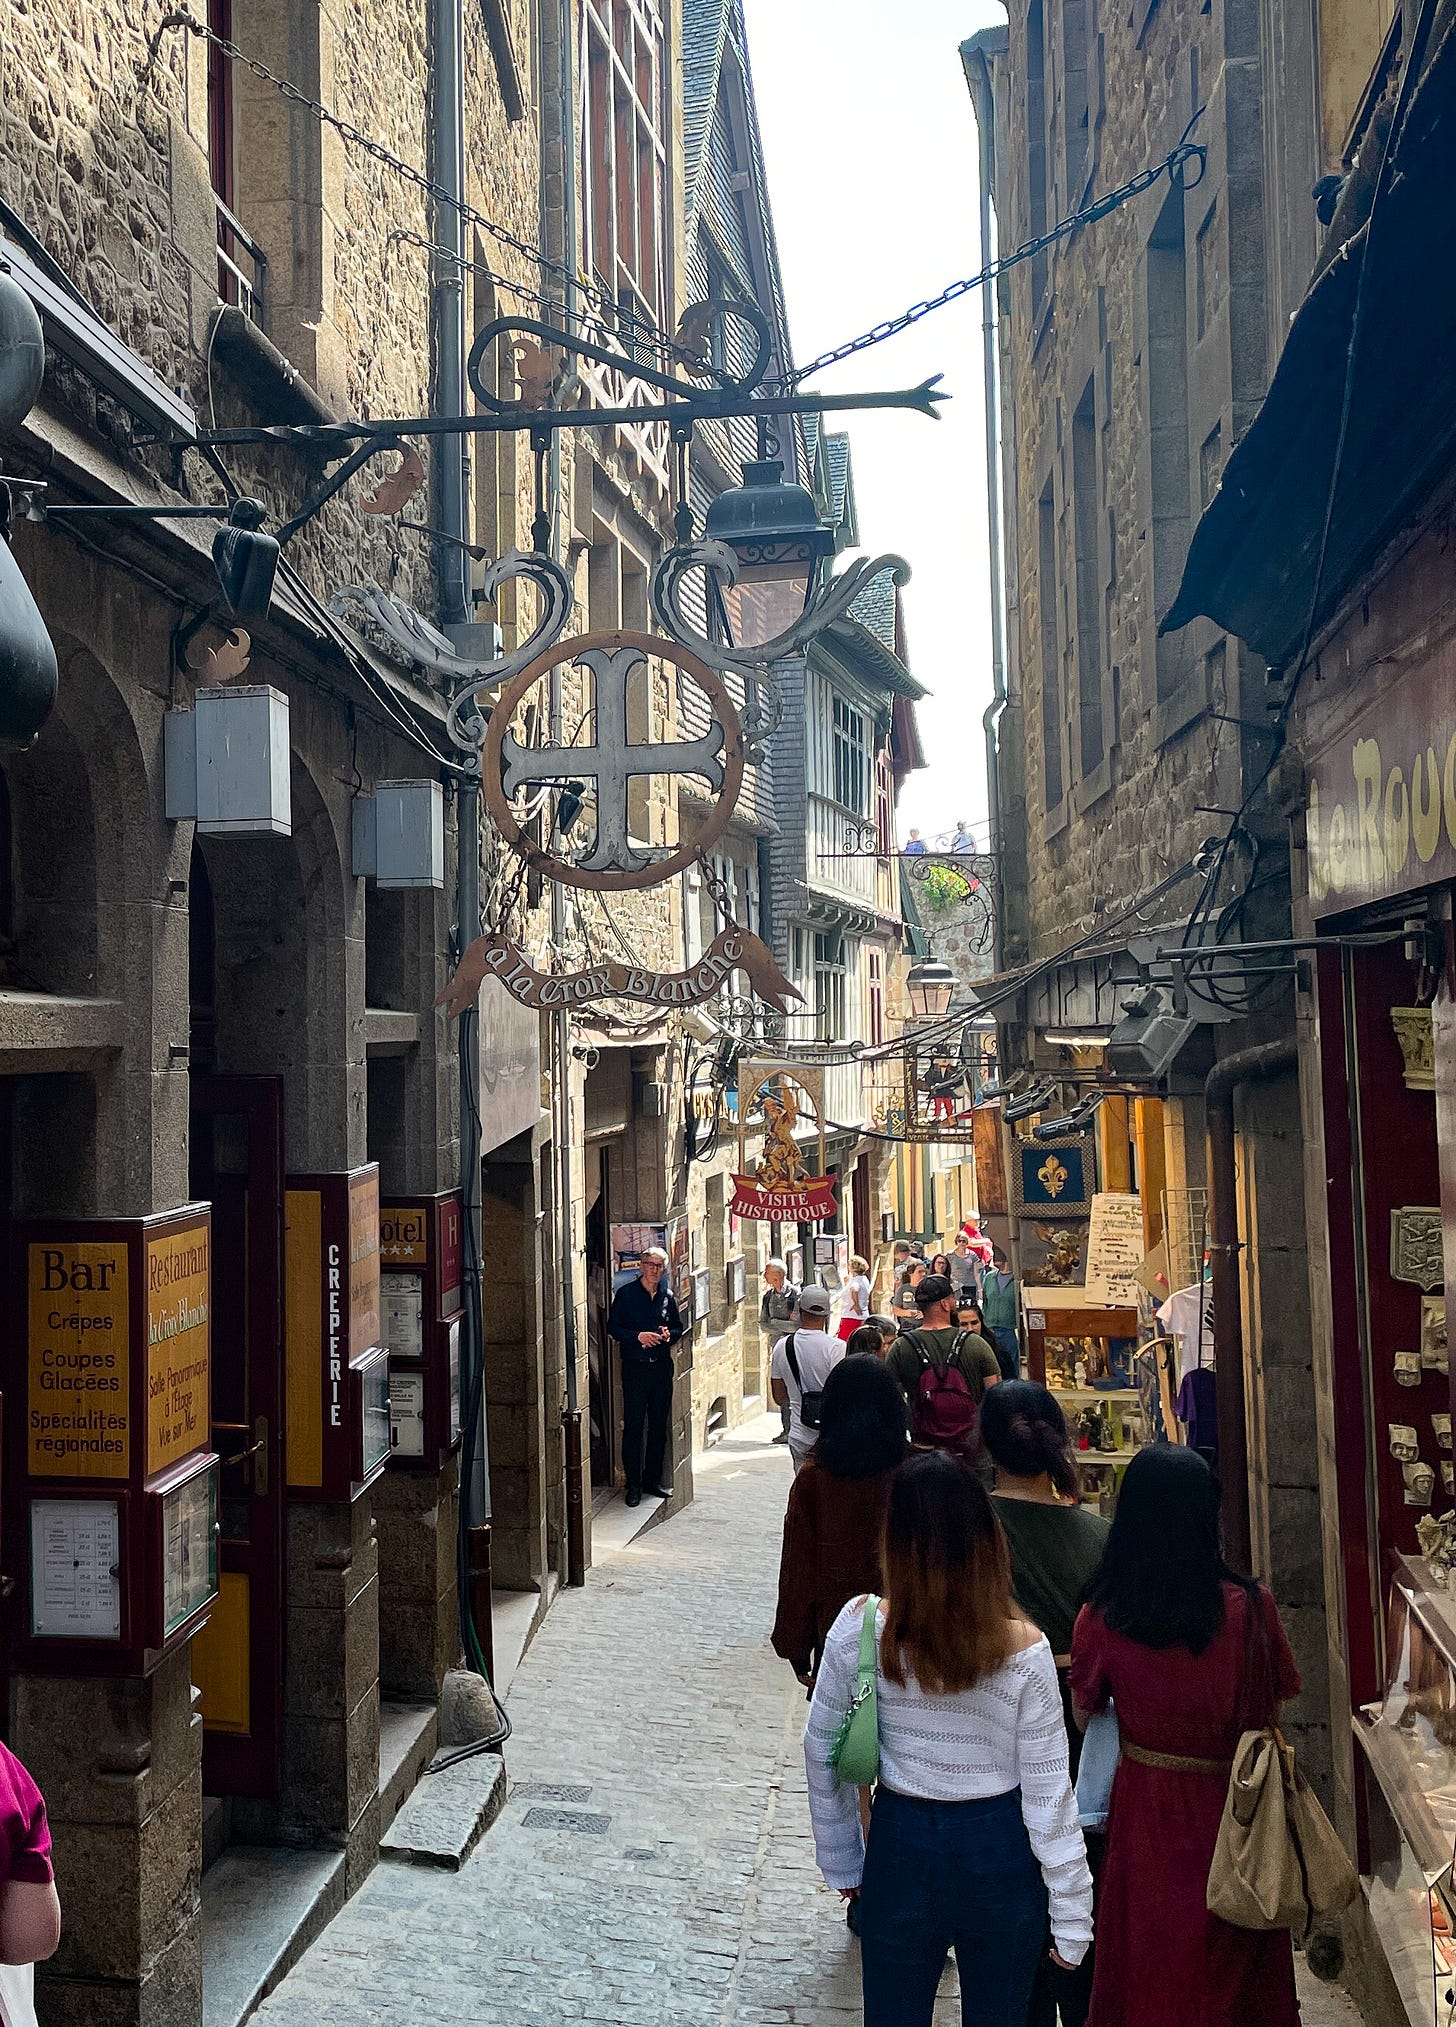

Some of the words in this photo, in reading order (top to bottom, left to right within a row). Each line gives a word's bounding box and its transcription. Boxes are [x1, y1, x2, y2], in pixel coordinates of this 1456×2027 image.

[1353, 731, 1456, 890] ROU
[500, 960, 535, 1000] la
[530, 967, 613, 1009] Croix
[617, 938, 744, 1003] Blanche
[736, 1200, 831, 1221] HISTORIQUE
[757, 1191, 809, 1207] VISITE
[380, 1215, 426, 1243] ôtel
[448, 1214, 458, 1248] H
[40, 1249, 117, 1292] Bar
[149, 1232, 208, 1294] Restaurant
[327, 1244, 342, 1427] CREPERIE
[41, 1348, 116, 1372] Coupes
[40, 1370, 120, 1391] Glacées
[149, 1371, 166, 1400] Salle
[167, 1358, 208, 1391] Panoramique
[30, 1408, 127, 1433] Spécialités
[158, 1425, 172, 1448] Vue
[172, 1422, 183, 1442] sur
[183, 1407, 198, 1432] Mer
[35, 1430, 124, 1458] régionales
